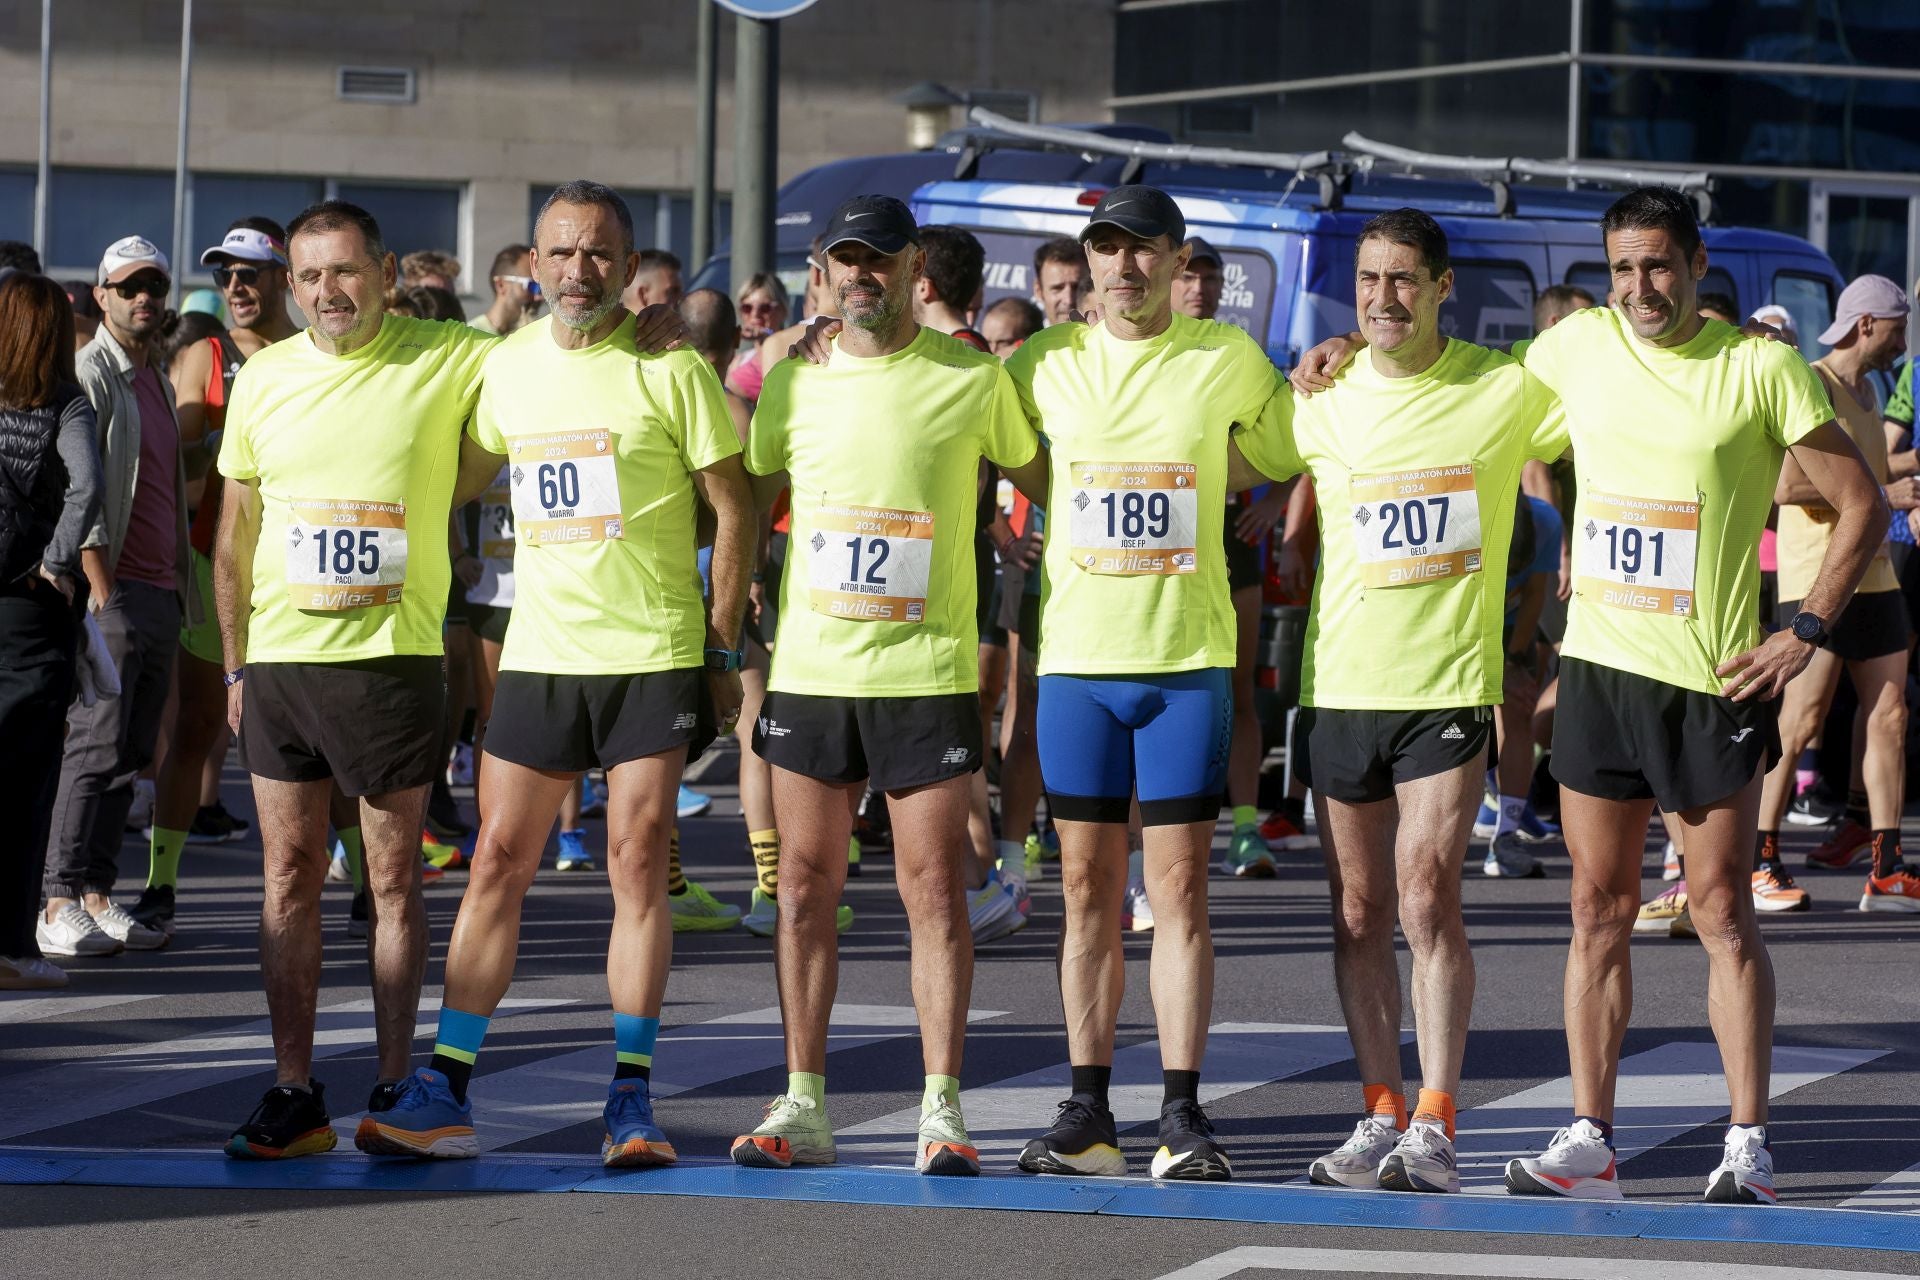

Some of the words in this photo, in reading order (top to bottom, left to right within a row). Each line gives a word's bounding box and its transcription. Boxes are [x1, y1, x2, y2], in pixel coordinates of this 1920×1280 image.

[548, 434, 582, 444] MARATÓN
[545, 447, 567, 457] 2024
[1099, 464, 1123, 473] MEDIA
[1125, 464, 1166, 473] MARATÓN
[1167, 463, 1195, 473] AVILÉS
[1375, 474, 1400, 484] MEDIA
[1401, 469, 1443, 482] MARATÓN
[1444, 465, 1471, 477] AVILÉS
[538, 462, 580, 509] 60
[1120, 476, 1147, 486] 2024
[1399, 484, 1425, 495] 2024
[337, 502, 377, 511] MARATÓN
[379, 504, 405, 515] AVILÉS
[1627, 499, 1666, 512] MARATÓN
[1667, 504, 1696, 514] AVILÉS
[332, 514, 359, 523] 2024
[547, 509, 574, 519] NAVARRO
[861, 510, 902, 520] MARATÓN
[904, 514, 931, 523] AVILÉS
[1100, 492, 1170, 538] 189
[1621, 511, 1647, 522] 2024
[855, 521, 882, 531] 2024
[1379, 496, 1450, 549] 207
[1121, 539, 1136, 548] JOSE
[1137, 539, 1146, 548] FP
[313, 529, 379, 575] 185
[1410, 546, 1427, 556] GELO
[1605, 525, 1664, 577] 191
[846, 536, 890, 584] 12
[335, 576, 352, 584] PACO
[840, 583, 859, 592] AITOR
[860, 584, 886, 594] BURGOS
